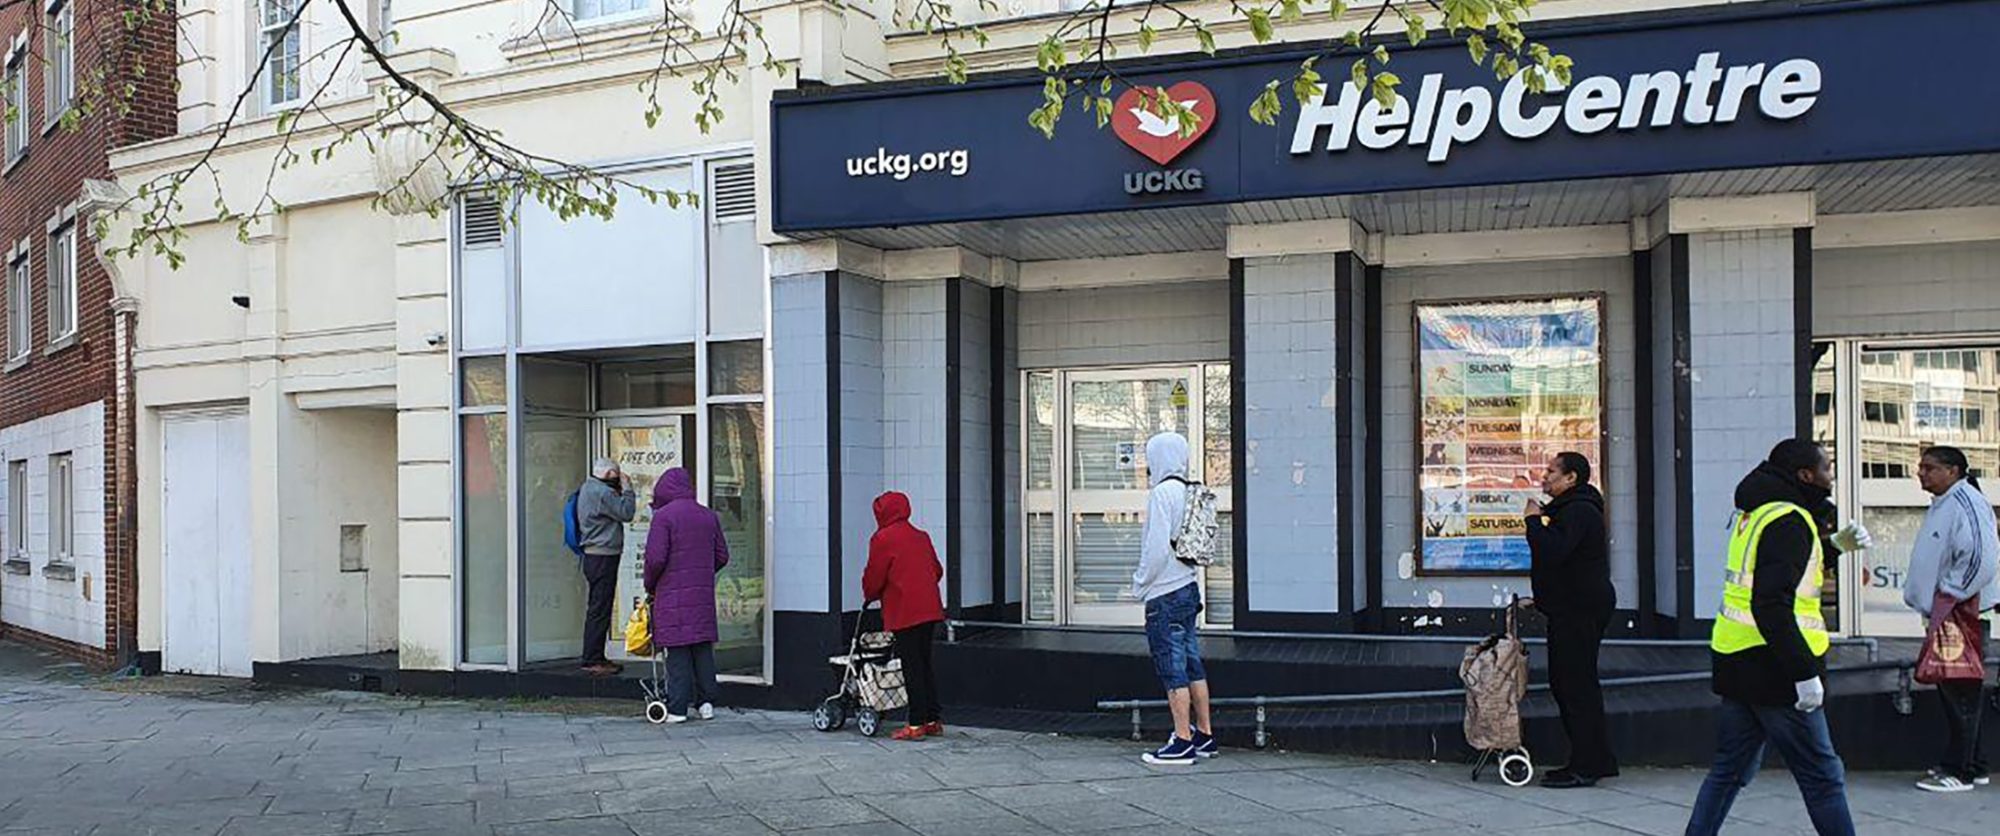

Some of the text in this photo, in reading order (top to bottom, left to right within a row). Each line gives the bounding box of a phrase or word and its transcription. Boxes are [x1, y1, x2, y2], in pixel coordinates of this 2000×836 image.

[846, 147, 969, 181] uckg.org
[1124, 168, 1203, 195] UCKG
[1468, 363, 1515, 375] SUNDAY
[1468, 396, 1520, 407] MONDAY
[1469, 422, 1522, 433] TUESDAY
[1468, 446, 1538, 456] WEDNESD
[620, 451, 676, 465] FREE SOUP
[1469, 518, 1526, 529] SATURDA
